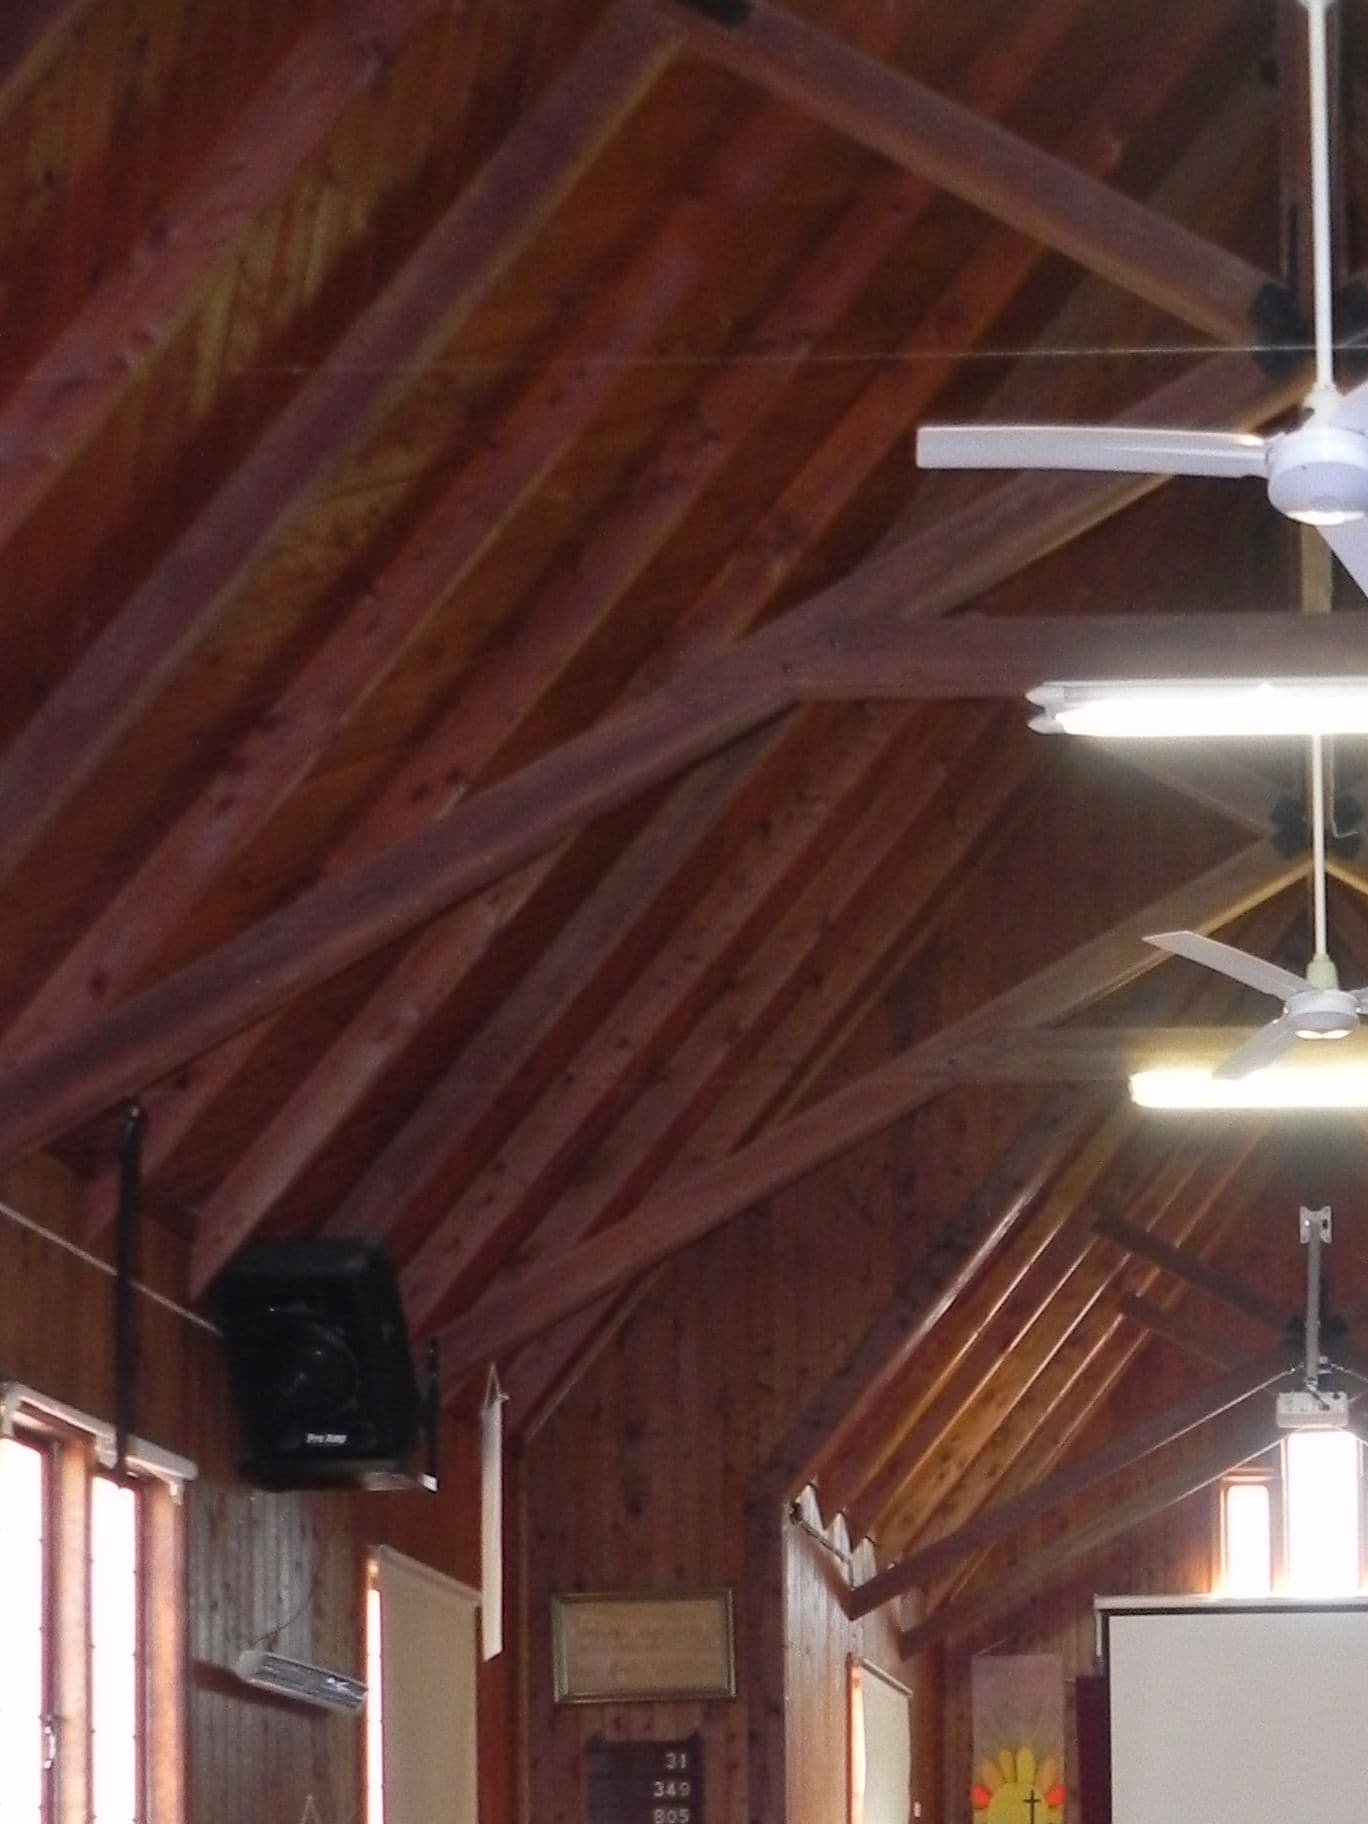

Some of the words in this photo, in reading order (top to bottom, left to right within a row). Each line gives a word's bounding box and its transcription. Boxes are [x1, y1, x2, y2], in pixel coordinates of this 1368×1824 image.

[665, 1752, 688, 1769] 31
[653, 1780, 691, 1797] 349
[653, 1808, 690, 1824] 805
